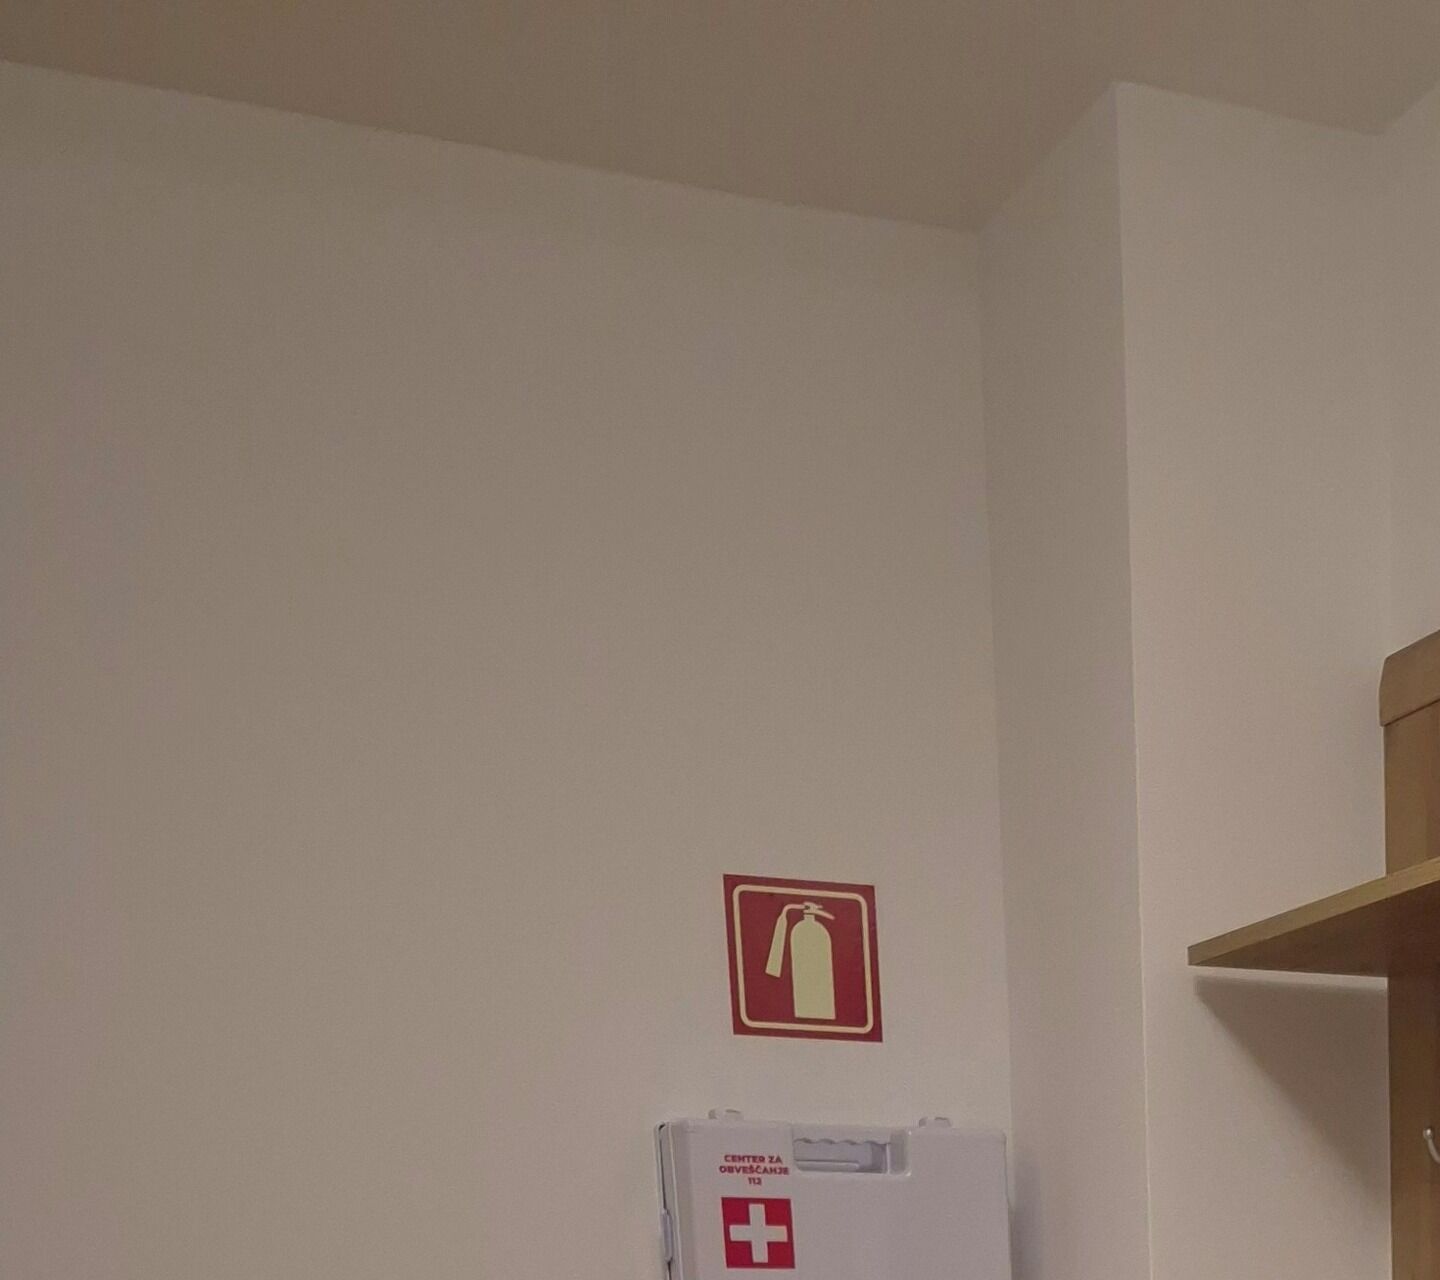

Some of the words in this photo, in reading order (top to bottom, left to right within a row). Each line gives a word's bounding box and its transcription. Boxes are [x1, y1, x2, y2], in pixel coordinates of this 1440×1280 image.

[724, 1154, 765, 1163] CENTER
[768, 1155, 783, 1164] ZA
[748, 1177, 762, 1186] 112
